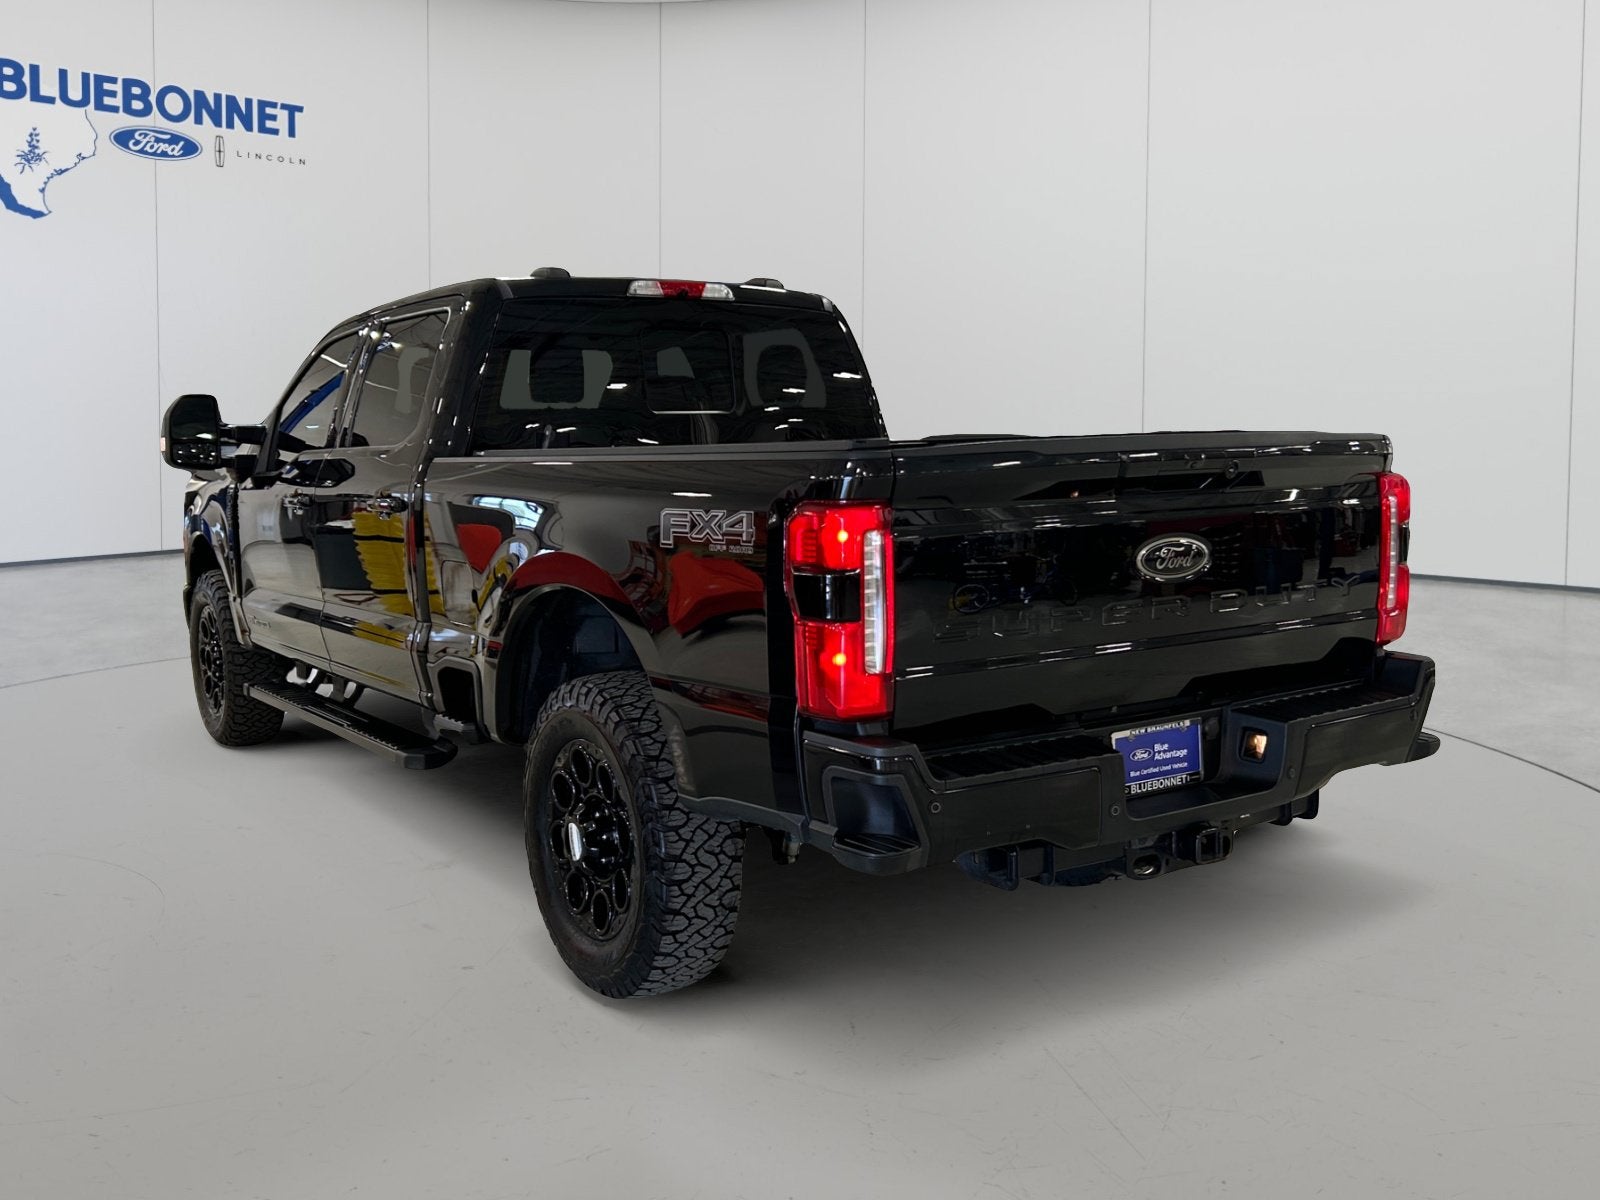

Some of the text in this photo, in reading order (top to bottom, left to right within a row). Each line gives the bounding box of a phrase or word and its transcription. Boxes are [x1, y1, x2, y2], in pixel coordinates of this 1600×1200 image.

[0, 57, 304, 138] BLUEBONNET
[129, 130, 184, 157] Ford
[236, 150, 306, 166] LINCOLN
[660, 508, 755, 548] FX4
[1155, 546, 1195, 570] Ford
[932, 574, 1360, 642] SUPER DUTY
[1154, 743, 1169, 752] Blue
[1154, 749, 1188, 760] Advantage
[1141, 767, 1159, 775] Certified
[1130, 774, 1187, 794] BLUEBONNET
